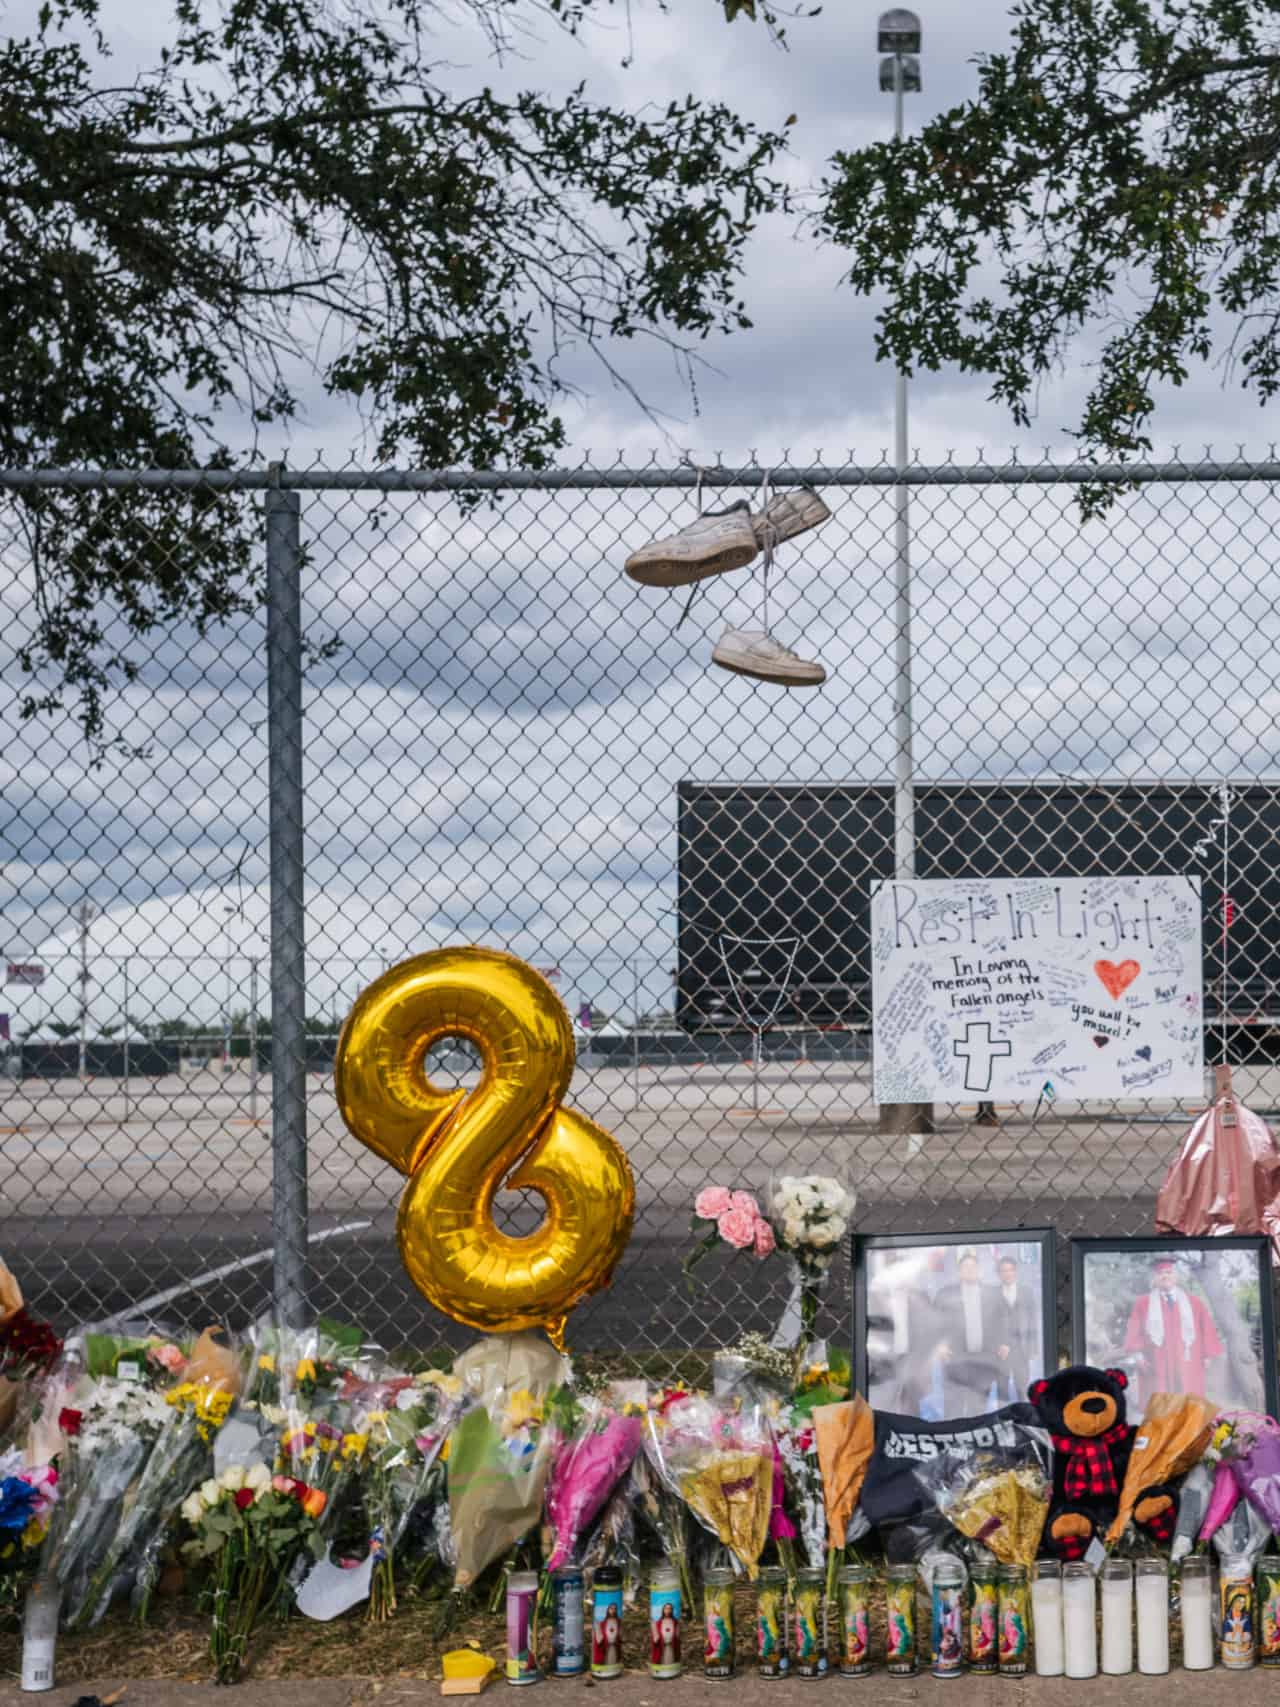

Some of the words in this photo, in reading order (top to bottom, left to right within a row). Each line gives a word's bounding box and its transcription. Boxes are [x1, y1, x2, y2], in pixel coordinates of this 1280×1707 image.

[892, 884, 991, 949] Rest
[1006, 893, 1038, 941] In
[1054, 886, 1162, 951] Light
[950, 954, 974, 977] In
[977, 958, 1031, 978] Loving
[931, 977, 992, 992] memory
[997, 973, 1013, 985] of
[1019, 973, 1040, 985] the
[951, 992, 992, 1008] Fallen
[996, 988, 1045, 1007] angels
[1071, 1003, 1095, 1022] you
[1098, 1009, 1123, 1022] will
[1126, 1014, 1142, 1029] be
